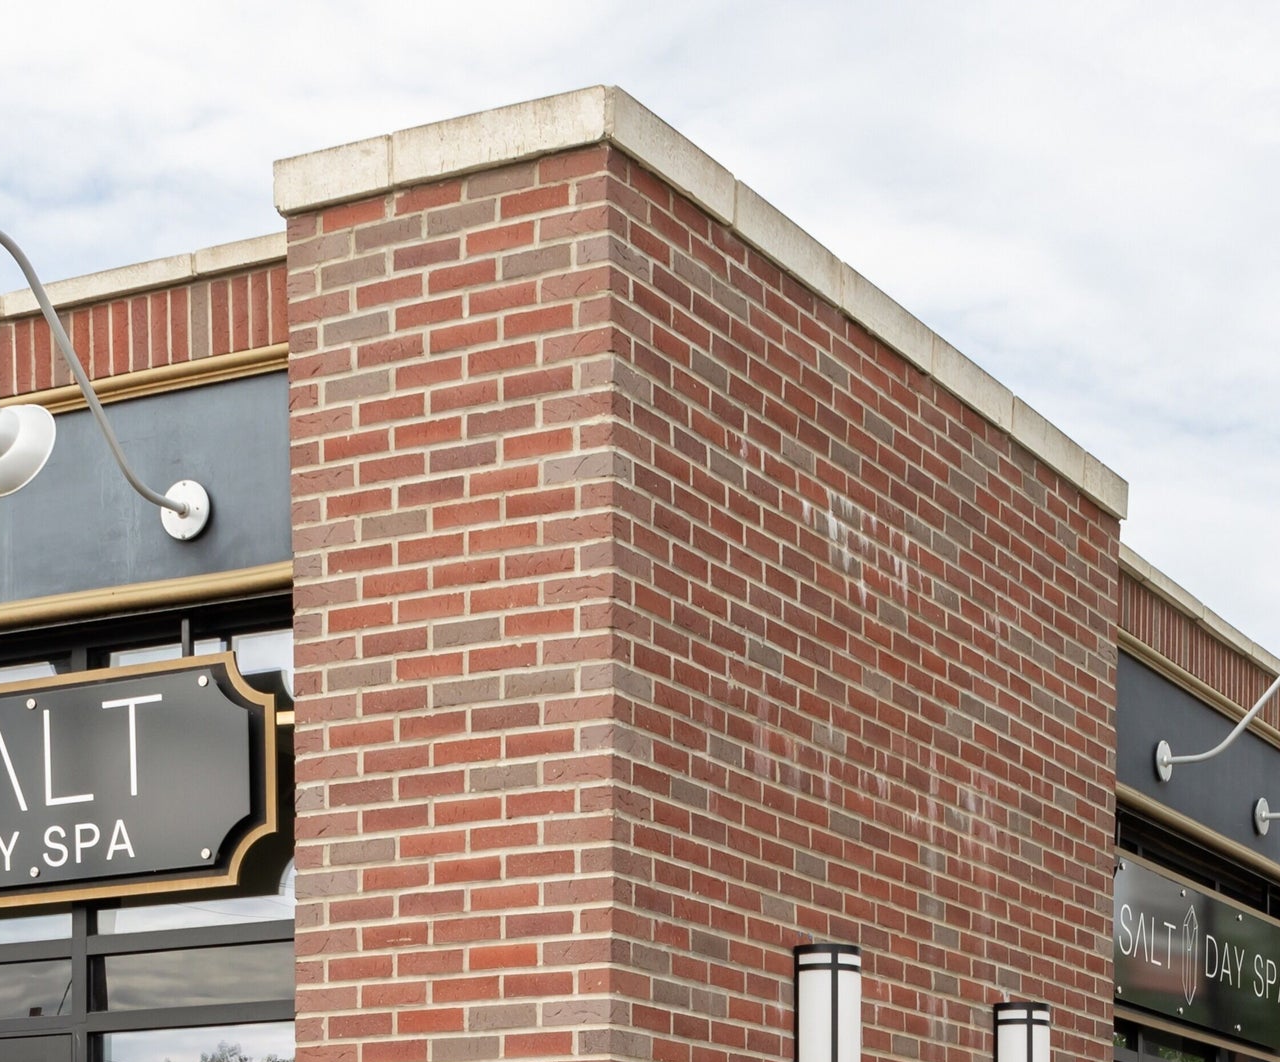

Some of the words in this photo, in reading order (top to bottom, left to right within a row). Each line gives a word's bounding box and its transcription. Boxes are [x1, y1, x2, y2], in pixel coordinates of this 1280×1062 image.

[42, 818, 136, 869] SPA
[1118, 903, 1177, 970] SALT
[1205, 934, 1245, 989] DAY
